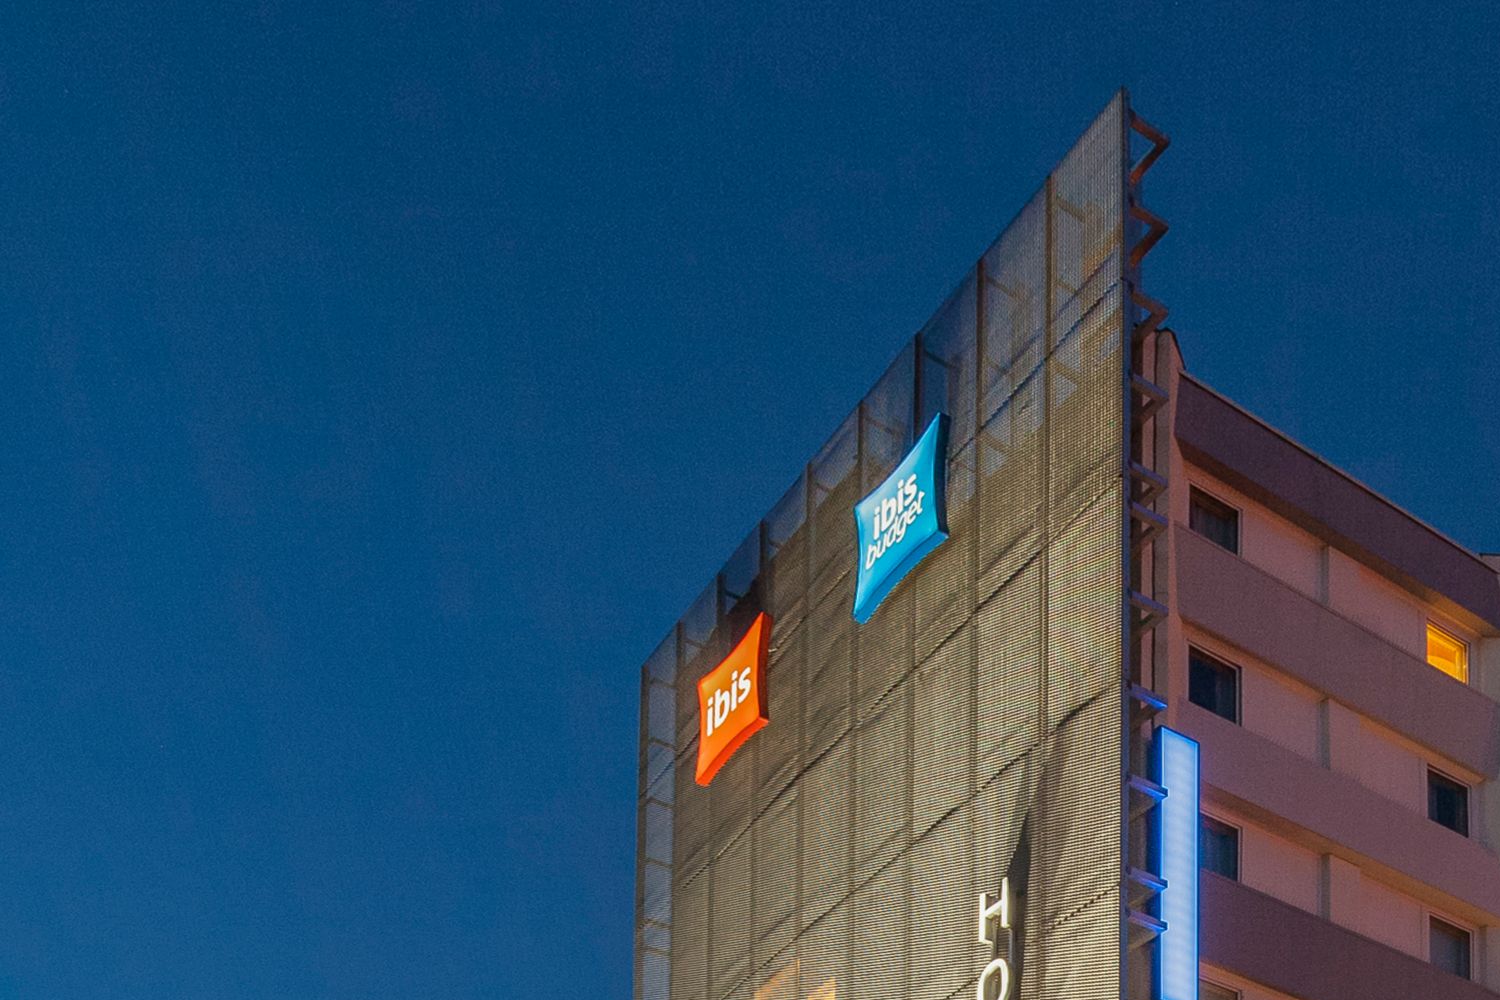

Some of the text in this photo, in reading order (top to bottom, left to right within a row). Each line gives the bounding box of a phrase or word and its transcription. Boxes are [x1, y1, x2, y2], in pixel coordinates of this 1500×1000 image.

[865, 490, 926, 571] budget
[872, 472, 917, 540] ibis
[706, 666, 752, 737] ibis
